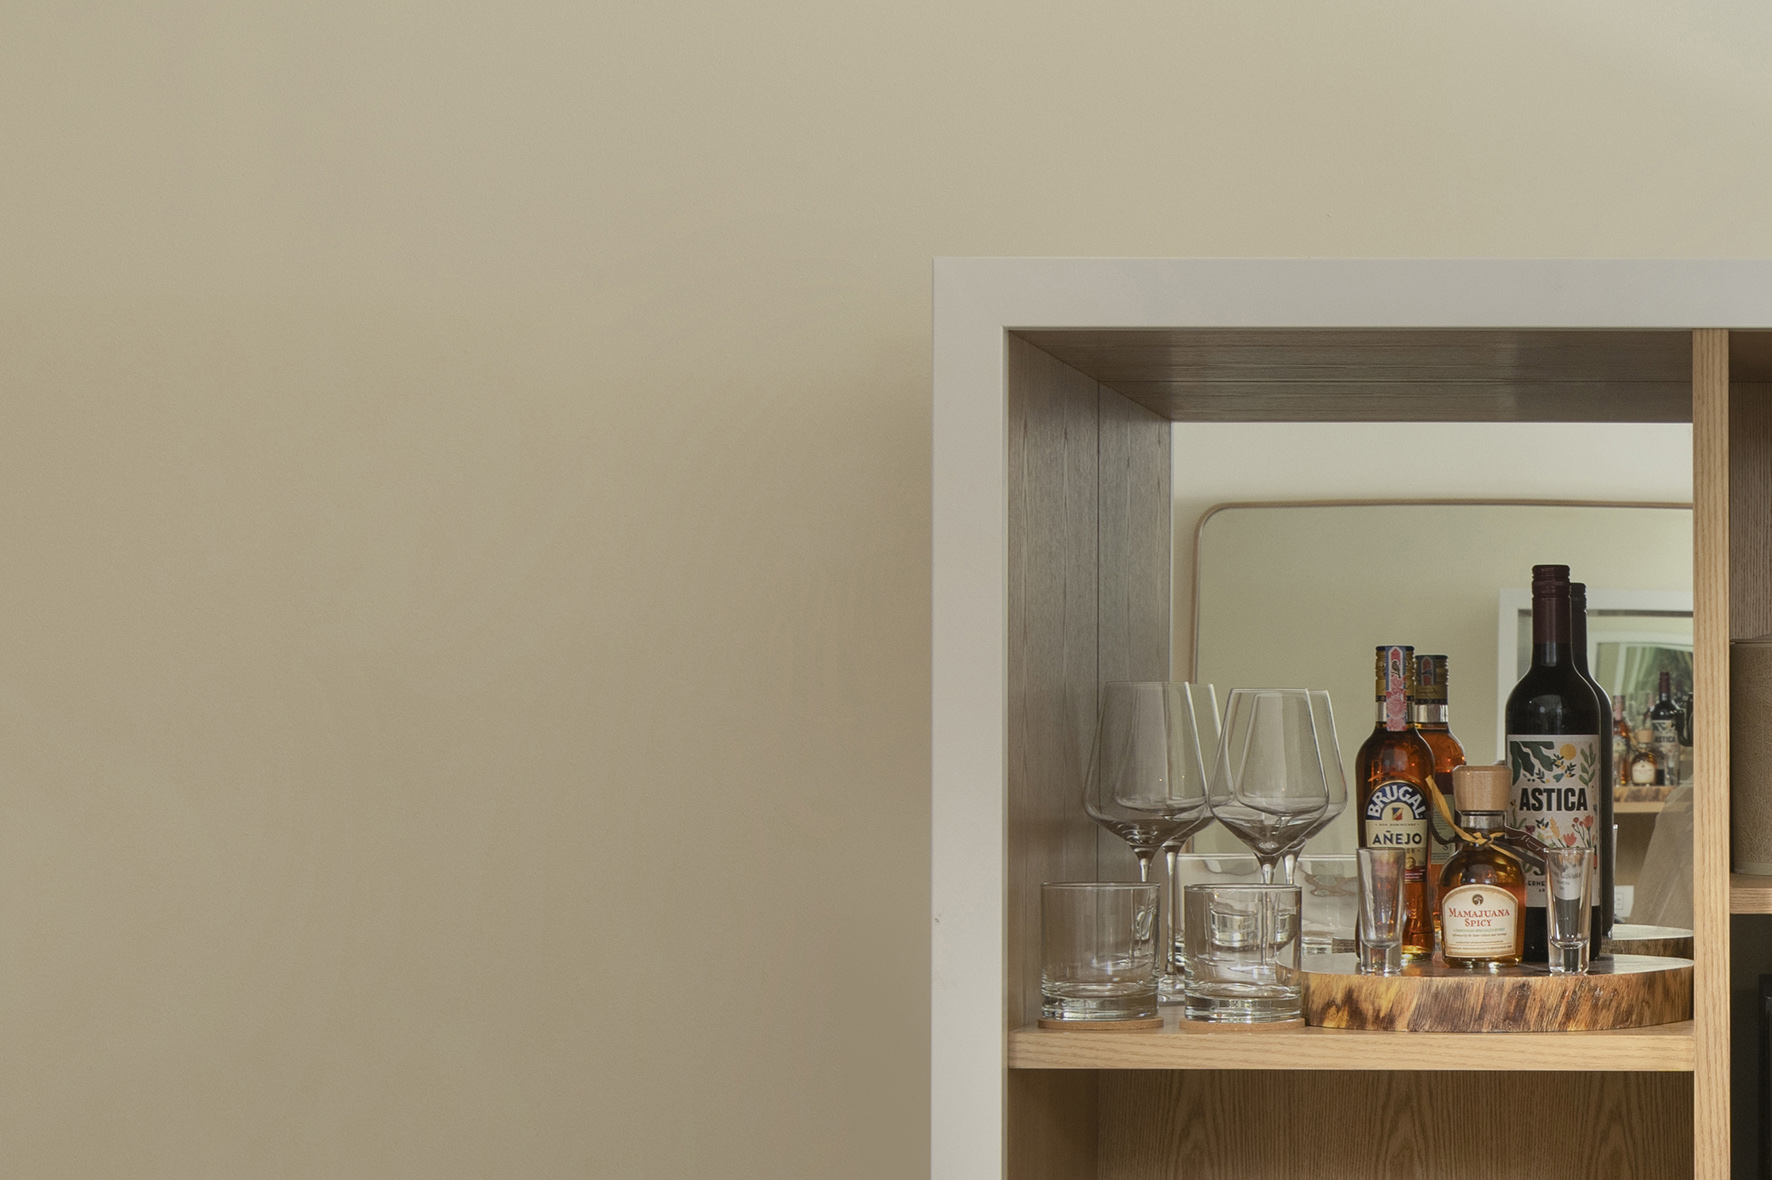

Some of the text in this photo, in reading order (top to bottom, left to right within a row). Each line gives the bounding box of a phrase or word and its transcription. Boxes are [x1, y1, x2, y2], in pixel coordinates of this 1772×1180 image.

[1367, 784, 1427, 819] BRUGAL
[1519, 787, 1588, 812] ASTICA
[1372, 829, 1423, 845] AÑEJO
[1448, 907, 1511, 918] MAMAJUANA
